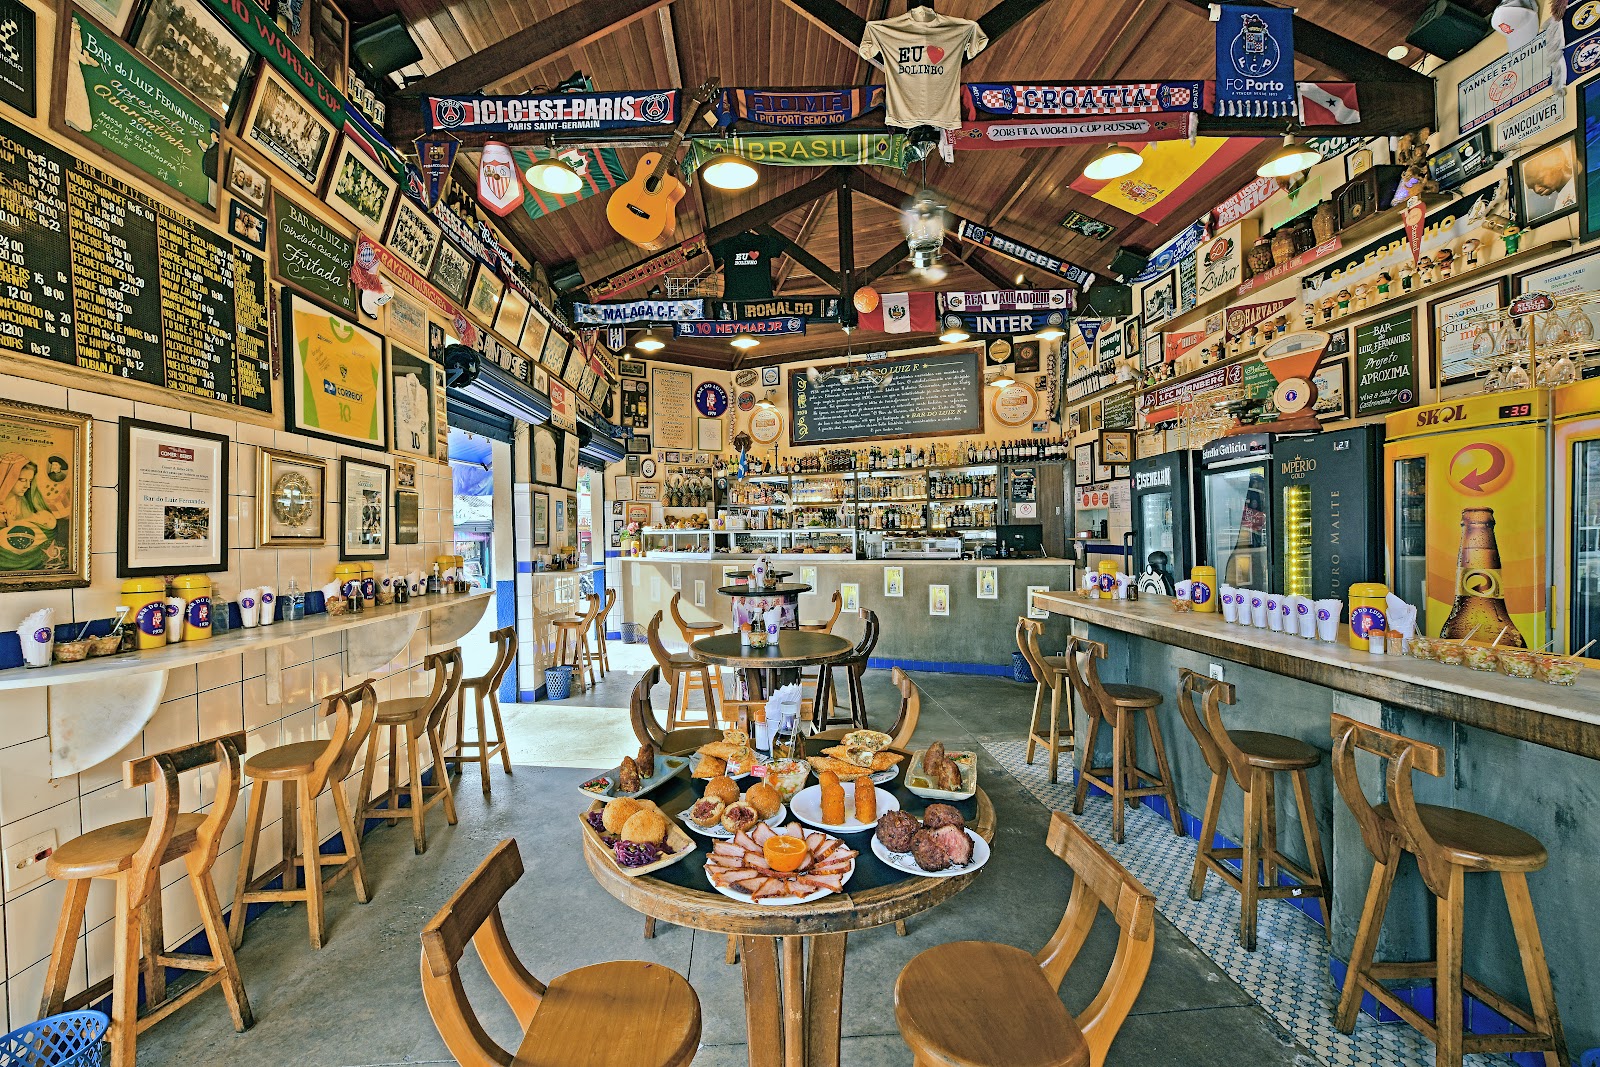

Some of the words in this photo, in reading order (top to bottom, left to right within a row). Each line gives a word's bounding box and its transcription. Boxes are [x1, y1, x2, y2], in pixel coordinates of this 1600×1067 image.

[899, 46, 924, 63] EU
[898, 64, 944, 75] BOLINHO
[1464, 69, 1499, 94] YANKEE
[1501, 40, 1546, 73] STADIUM
[86, 33, 112, 68] BAR
[115, 62, 127, 78] do
[128, 71, 154, 98] LUIZ
[155, 91, 205, 134] FERNANDES
[1226, 79, 1243, 90] FC
[1246, 79, 1284, 91] Porto
[110, 78, 185, 137] apresenta
[753, 94, 850, 112] ROMA
[1023, 88, 1151, 109] CROATIA
[473, 99, 504, 125] ICI
[508, 98, 567, 122] C'EST
[572, 96, 635, 121] PARIS
[776, 114, 802, 124] FORTI
[804, 115, 827, 124] SEMO
[829, 114, 845, 124] NOI
[94, 84, 193, 157] Quarentinha
[508, 122, 532, 131] PARIS
[534, 120, 600, 130] SAINT-GERMAIN
[1503, 104, 1557, 140] VANCOUVER
[99, 111, 123, 130] MASSA
[125, 128, 134, 136] DE
[135, 133, 161, 154] BATATA
[102, 130, 129, 150] ALICHE
[992, 128, 1015, 137] 2018
[1017, 126, 1038, 136] FIFA
[1040, 125, 1078, 135] WORLD
[1080, 124, 1101, 133] CUP
[1518, 126, 1540, 139] CANADA
[96, 118, 121, 138] MIOLO
[124, 134, 133, 144] DE
[134, 140, 176, 172] ALCACHOFRA
[748, 139, 854, 161] BRASIL
[893, 135, 902, 163] BRASIL
[69, 171, 92, 190] VODKA
[76, 159, 96, 176] BAR
[118, 181, 138, 199] LUIZ
[1217, 198, 1240, 213] SPORT
[1219, 180, 1280, 225] BENFICA
[72, 217, 102, 238] BACARDI
[289, 206, 308, 228] BAR
[320, 225, 343, 250] LUIZ
[72, 242, 105, 261] CARPANO
[993, 238, 1060, 272] BRUGGE
[1330, 260, 1363, 283] S.C.
[1364, 214, 1456, 266] ESPIHO
[73, 252, 100, 270] FERNET
[100, 262, 127, 282] BRANCA
[74, 264, 112, 286] BAGACEIRA
[282, 244, 344, 287] Fritada
[76, 299, 106, 316] CINZANO
[964, 293, 989, 305] REAL
[992, 292, 1050, 304] VALLADOLID
[1466, 302, 1493, 314] PAULO
[1517, 299, 1545, 307] STELLA
[1517, 304, 1545, 312] ARTOIS
[604, 304, 652, 320] MALAGA
[657, 305, 676, 318] C.F.
[746, 302, 813, 317] RONALDO
[1245, 300, 1284, 327] HARVARD
[77, 323, 100, 336] SOLAR
[696, 324, 711, 334] 10
[716, 322, 766, 333] NEYMAR
[768, 322, 782, 331] JR
[976, 315, 1034, 332] INTER
[1373, 322, 1392, 336] BAR
[1100, 333, 1120, 347] Beverly
[1359, 344, 1373, 354] LUIZ
[1371, 333, 1410, 354] FERNANDES
[79, 345, 100, 359] VINHO
[1100, 349, 1114, 361] Hills
[1364, 352, 1398, 370] Projeto
[890, 365, 910, 373] LUIZ
[1360, 365, 1410, 386] APROXIMA
[337, 388, 363, 402] CORREIOS
[339, 402, 351, 422] 10
[18, 436, 54, 445] Fernandes
[411, 431, 420, 450] 10
[1220, 442, 1247, 456] Galicia
[1136, 466, 1171, 490] EISENBAHN
[1330, 490, 1340, 545] MALTE
[1330, 554, 1340, 598] PURO
[1369, 609, 1382, 619] LUIZ
